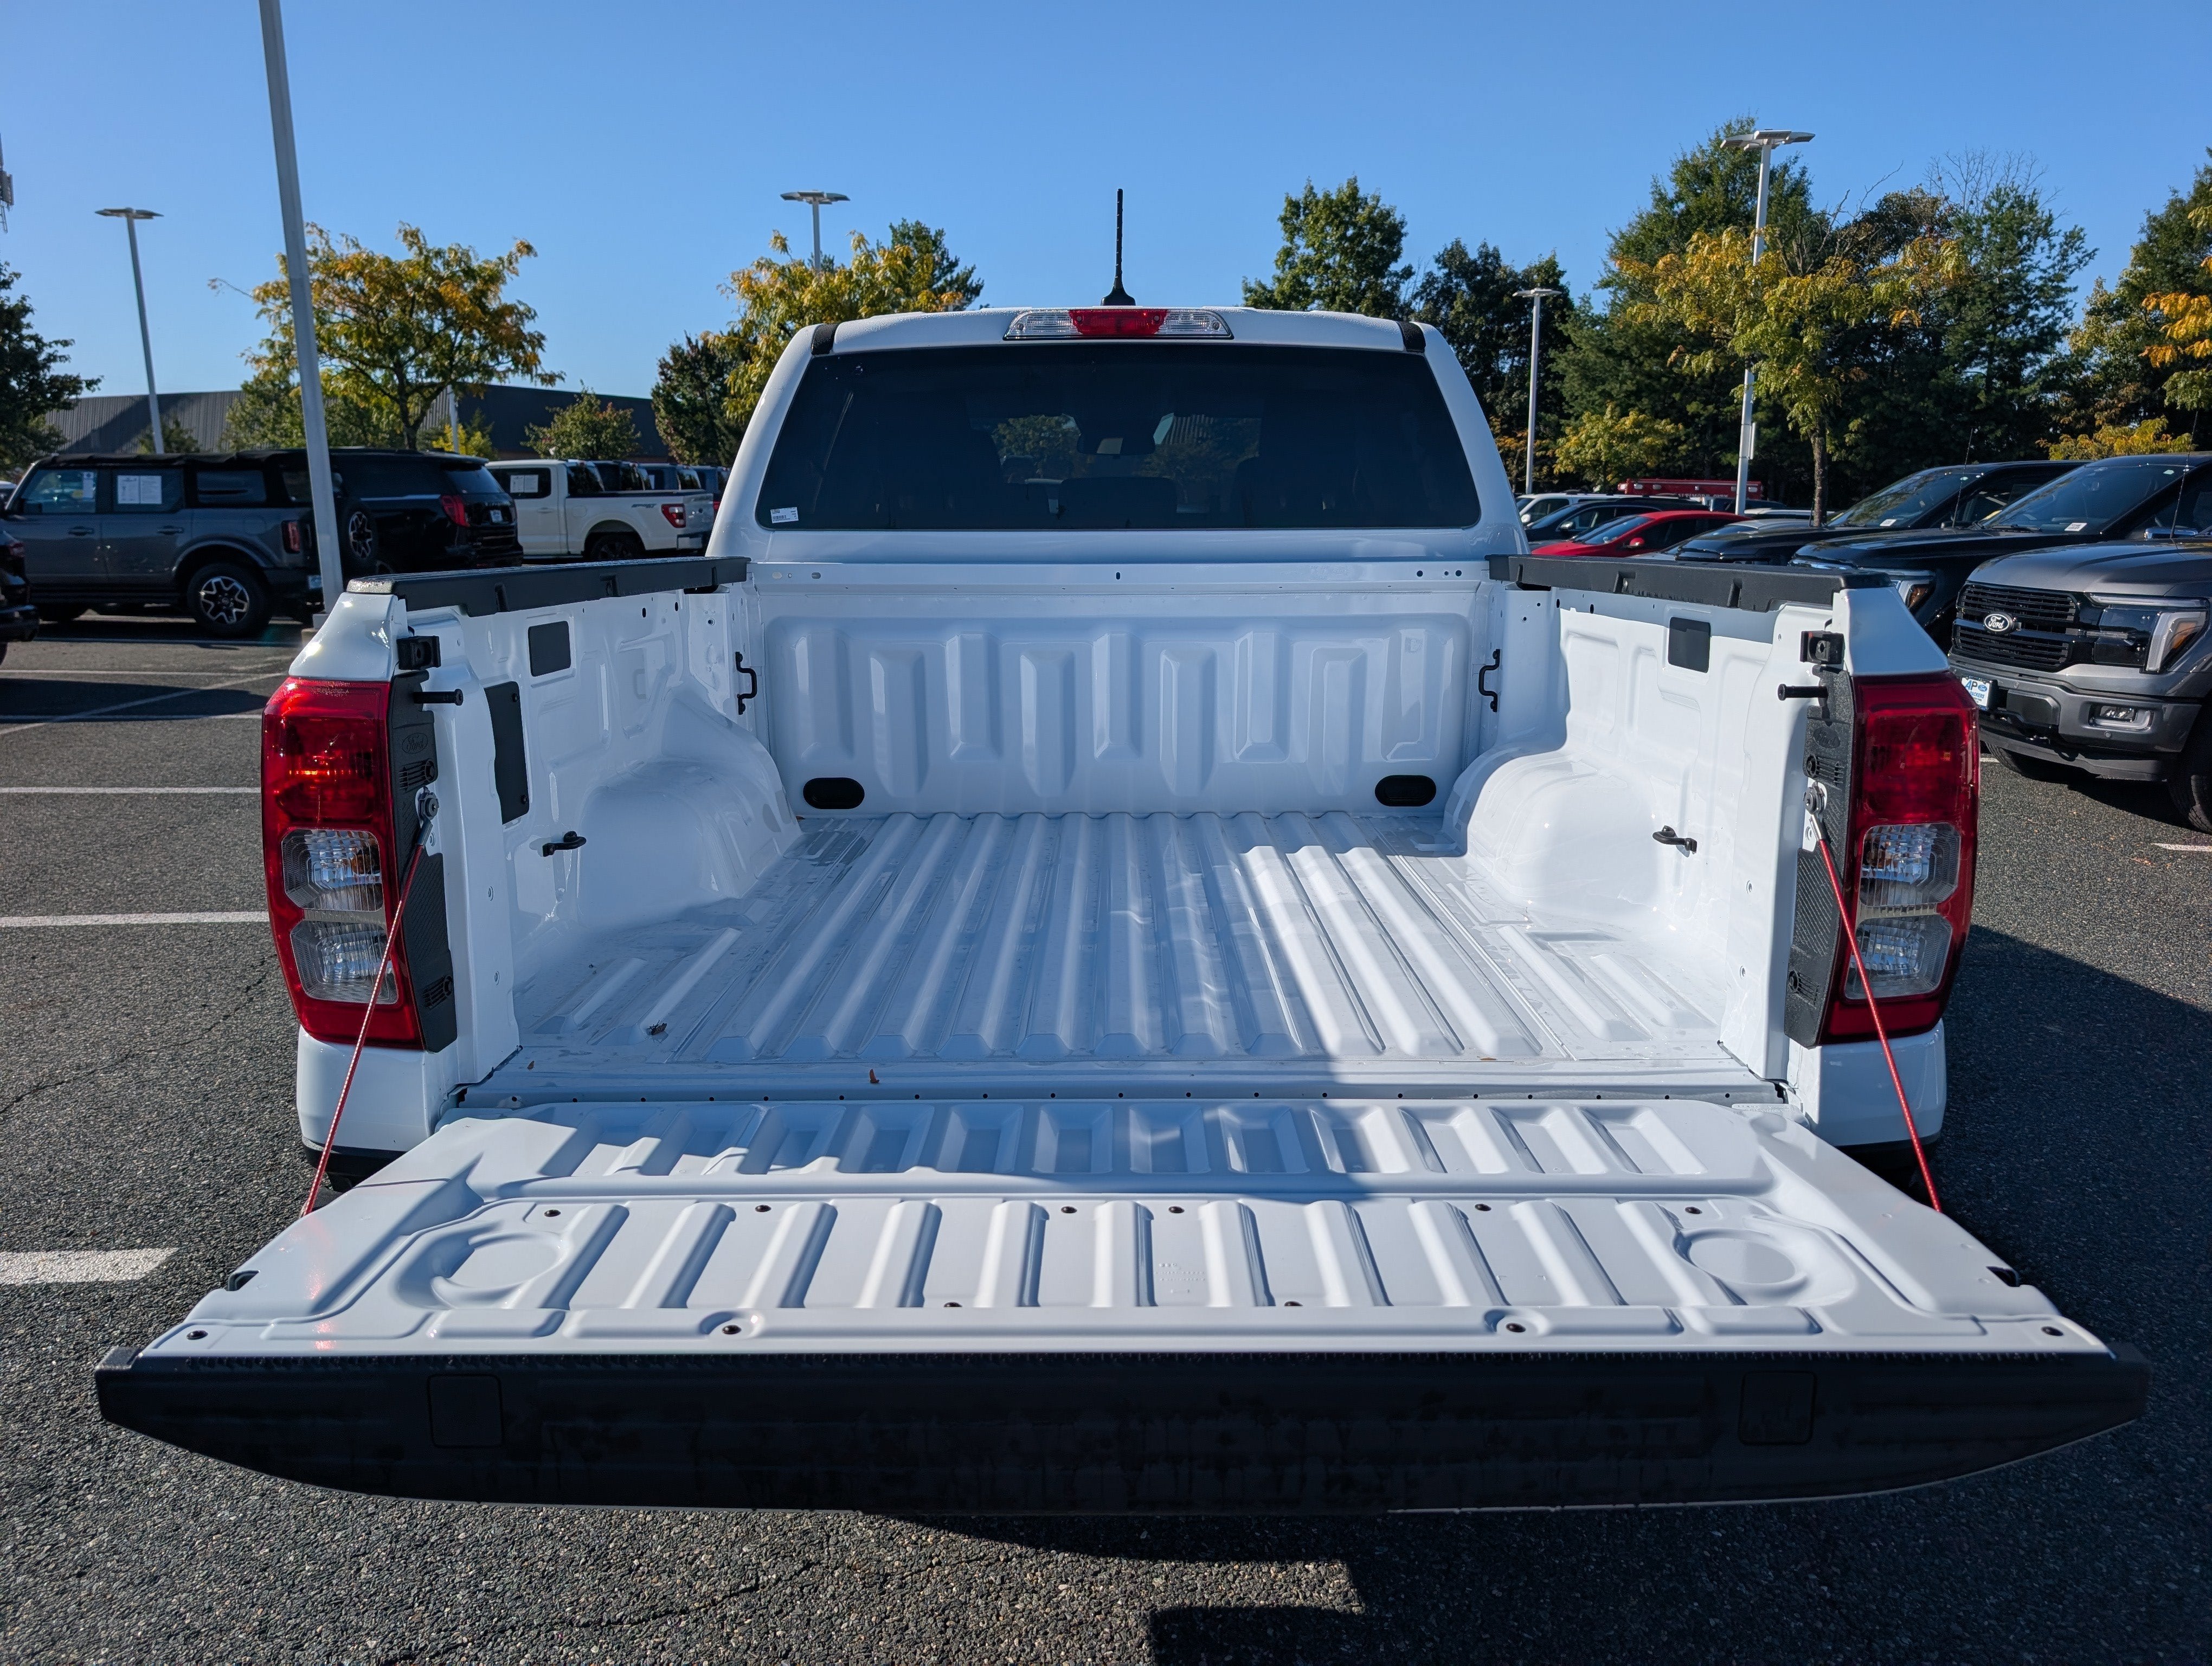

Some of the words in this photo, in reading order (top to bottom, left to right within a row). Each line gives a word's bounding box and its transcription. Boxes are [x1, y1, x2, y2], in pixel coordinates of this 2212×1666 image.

[1988, 616, 2005, 629] Ford
[1965, 680, 1978, 690] AP
[406, 735, 425, 752] Ford
